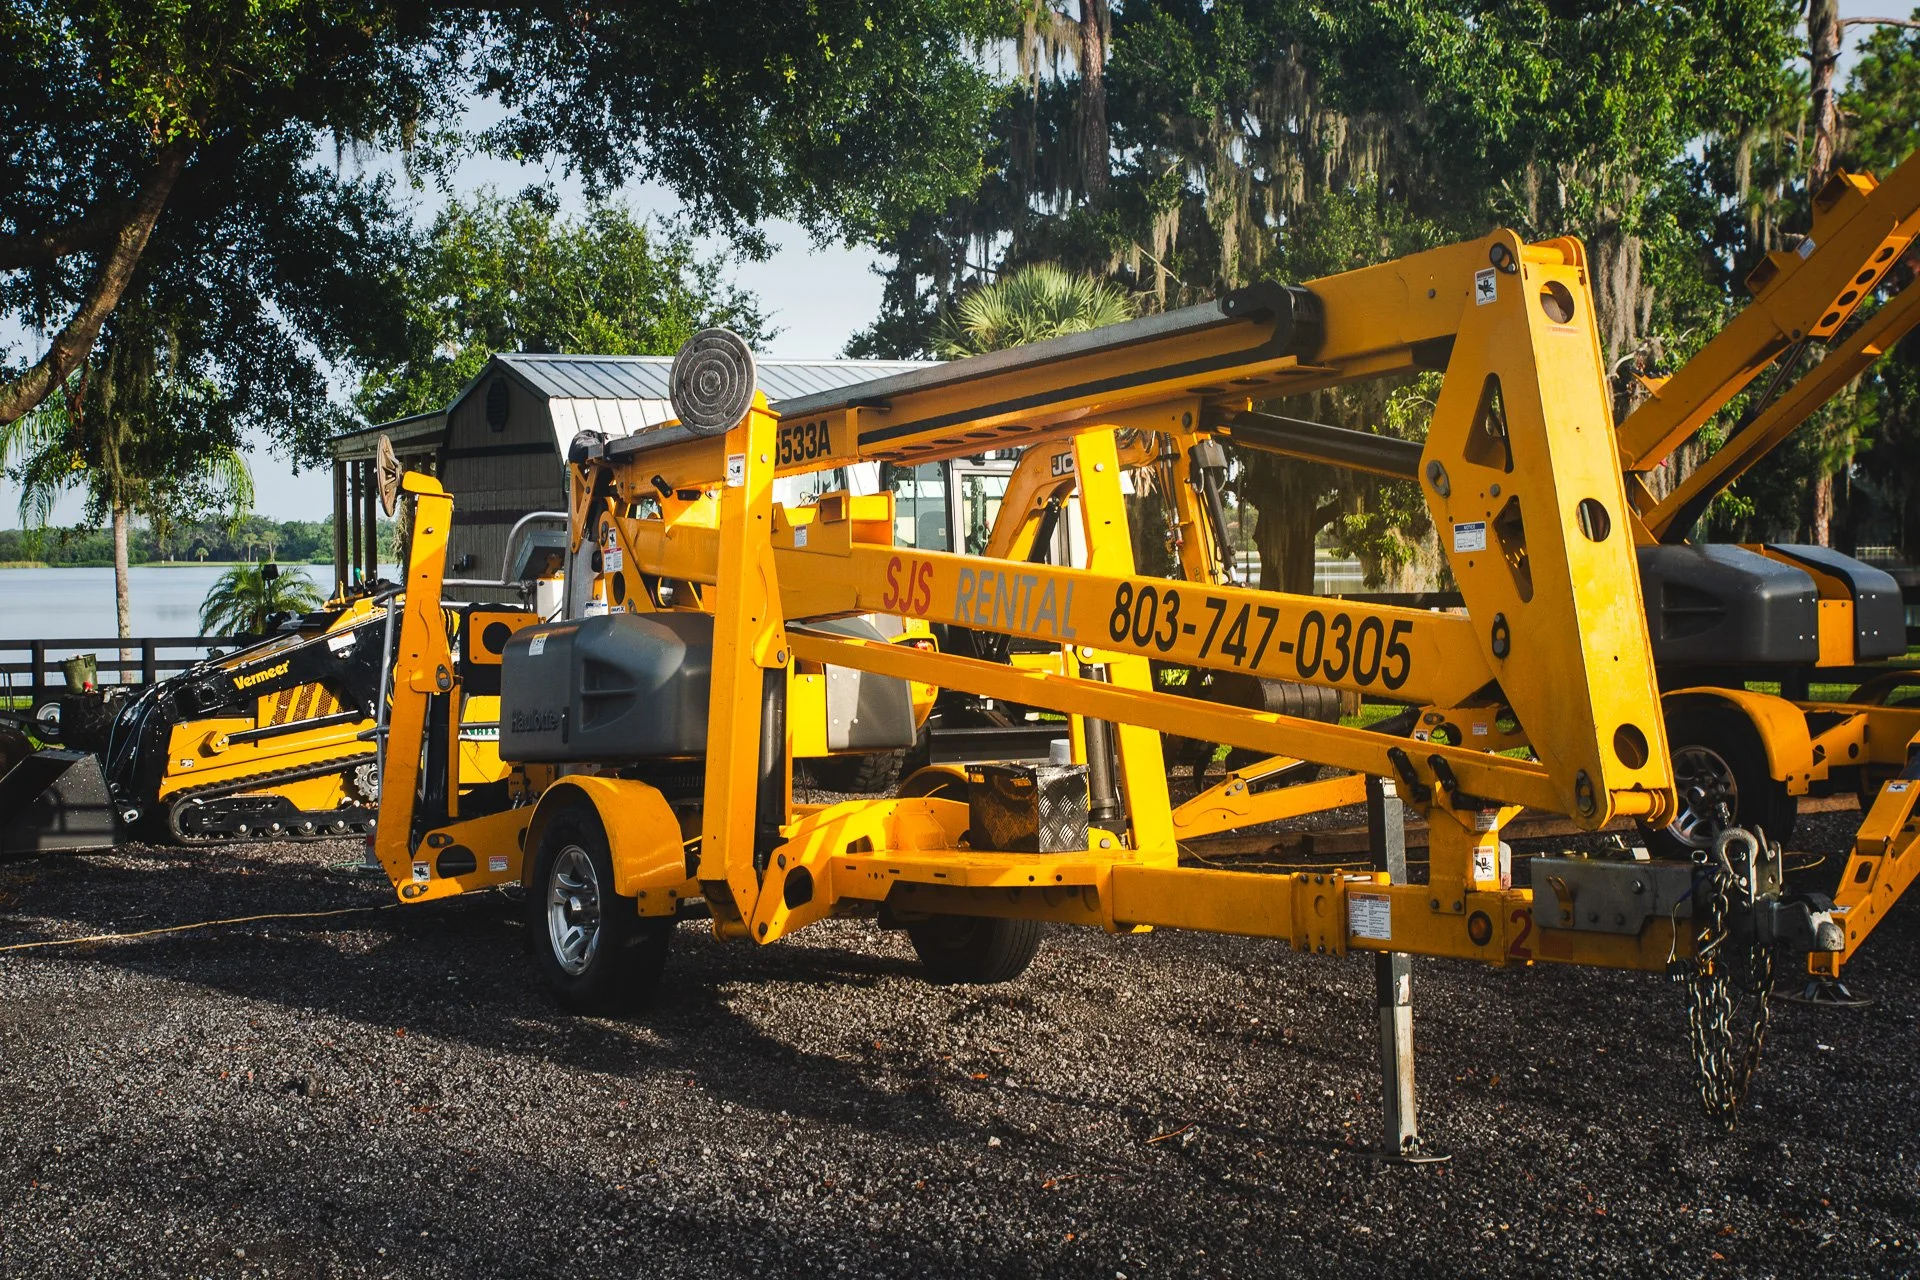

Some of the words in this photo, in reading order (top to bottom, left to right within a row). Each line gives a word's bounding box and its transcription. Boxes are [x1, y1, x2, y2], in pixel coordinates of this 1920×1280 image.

[1052, 453, 1074, 476] JC
[883, 556, 934, 616] SJS
[954, 567, 1077, 639] RENTAL
[1109, 581, 1414, 691] 803-747-0305
[233, 661, 289, 690] Vermeer
[1509, 908, 1532, 957] 2
